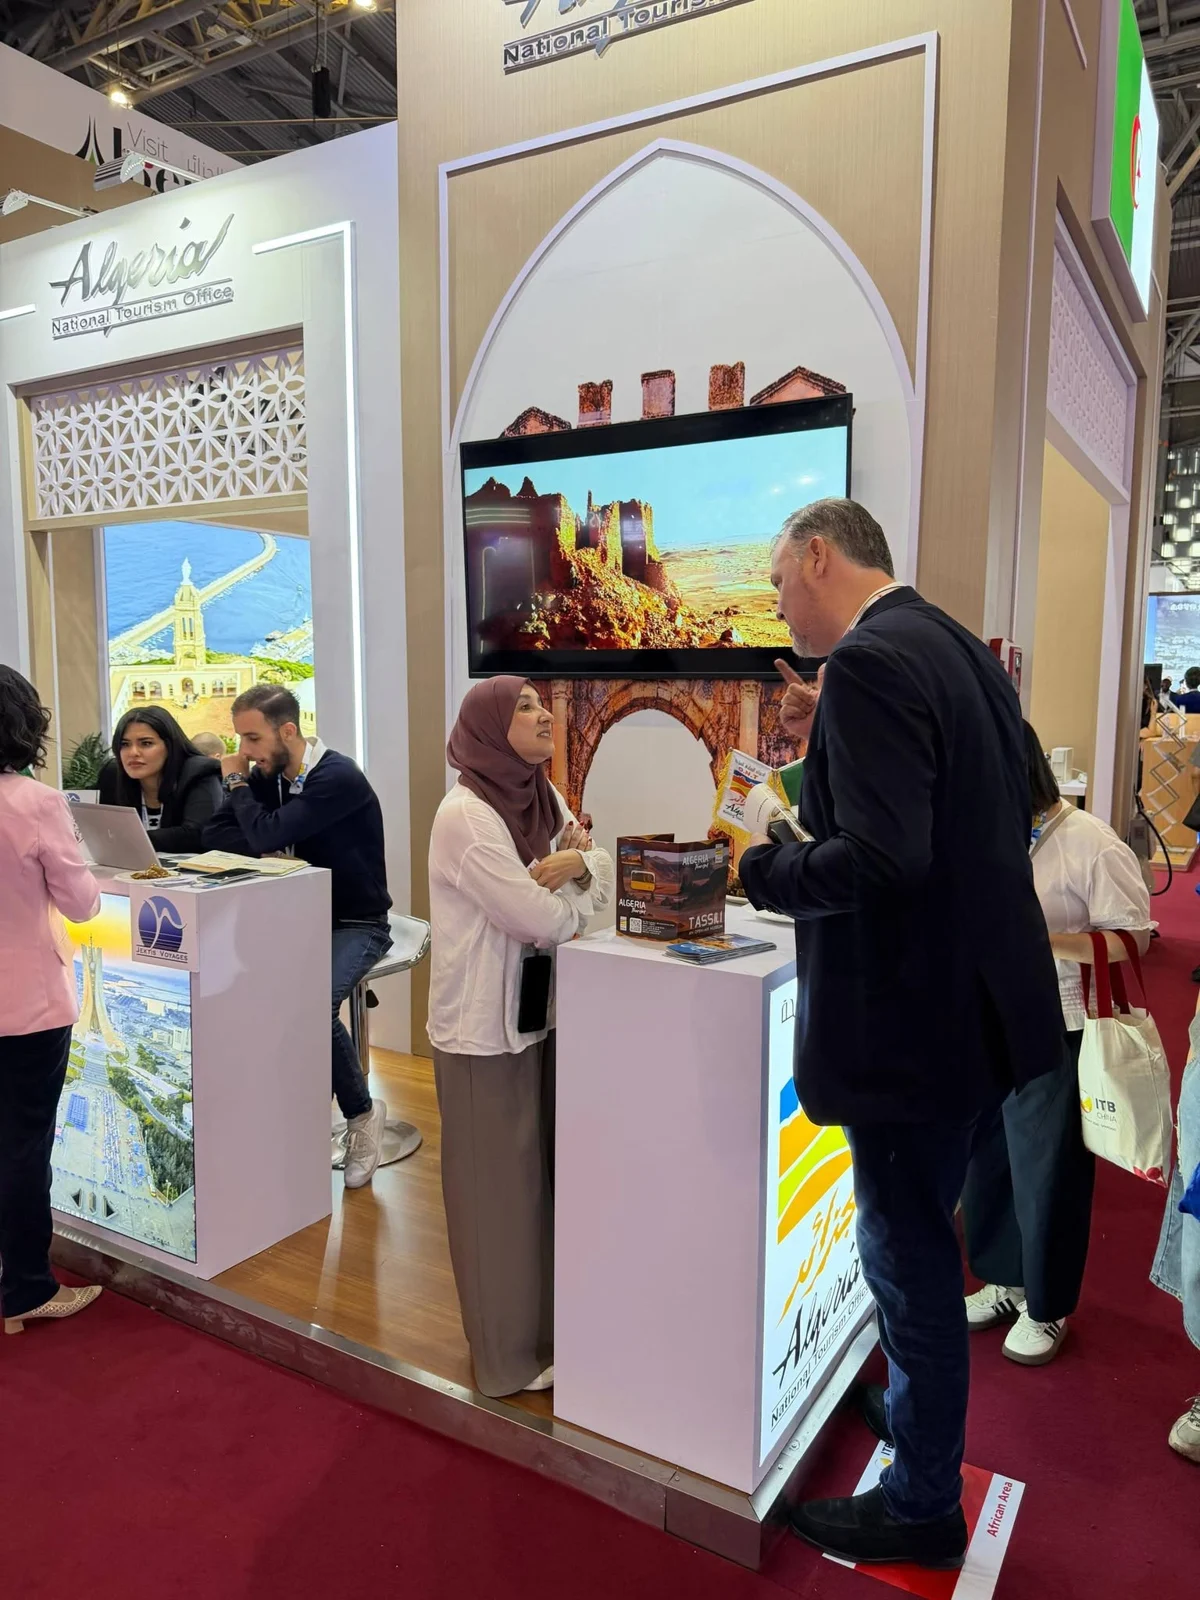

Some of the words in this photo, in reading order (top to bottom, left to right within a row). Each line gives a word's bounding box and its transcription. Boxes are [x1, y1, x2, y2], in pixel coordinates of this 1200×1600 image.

[503, 17, 610, 65] National
[617, 0, 718, 31] Touris
[126, 121, 169, 163] Visit
[48, 213, 236, 337] Algeria
[51, 309, 111, 335] National
[115, 298, 178, 321] Tourism
[183, 285, 235, 307] Office
[682, 853, 709, 867] ALGERIA
[618, 898, 647, 910] ALGERIA
[136, 946, 157, 956] JEKTIS
[160, 950, 188, 961] VOYAGES
[1095, 1098, 1116, 1112] ITB
[770, 1365, 812, 1428] National
[813, 1315, 847, 1365] Tourism
[848, 1285, 871, 1316] Offic
[986, 1503, 1007, 1538] African
[998, 1481, 1013, 1503] Area
